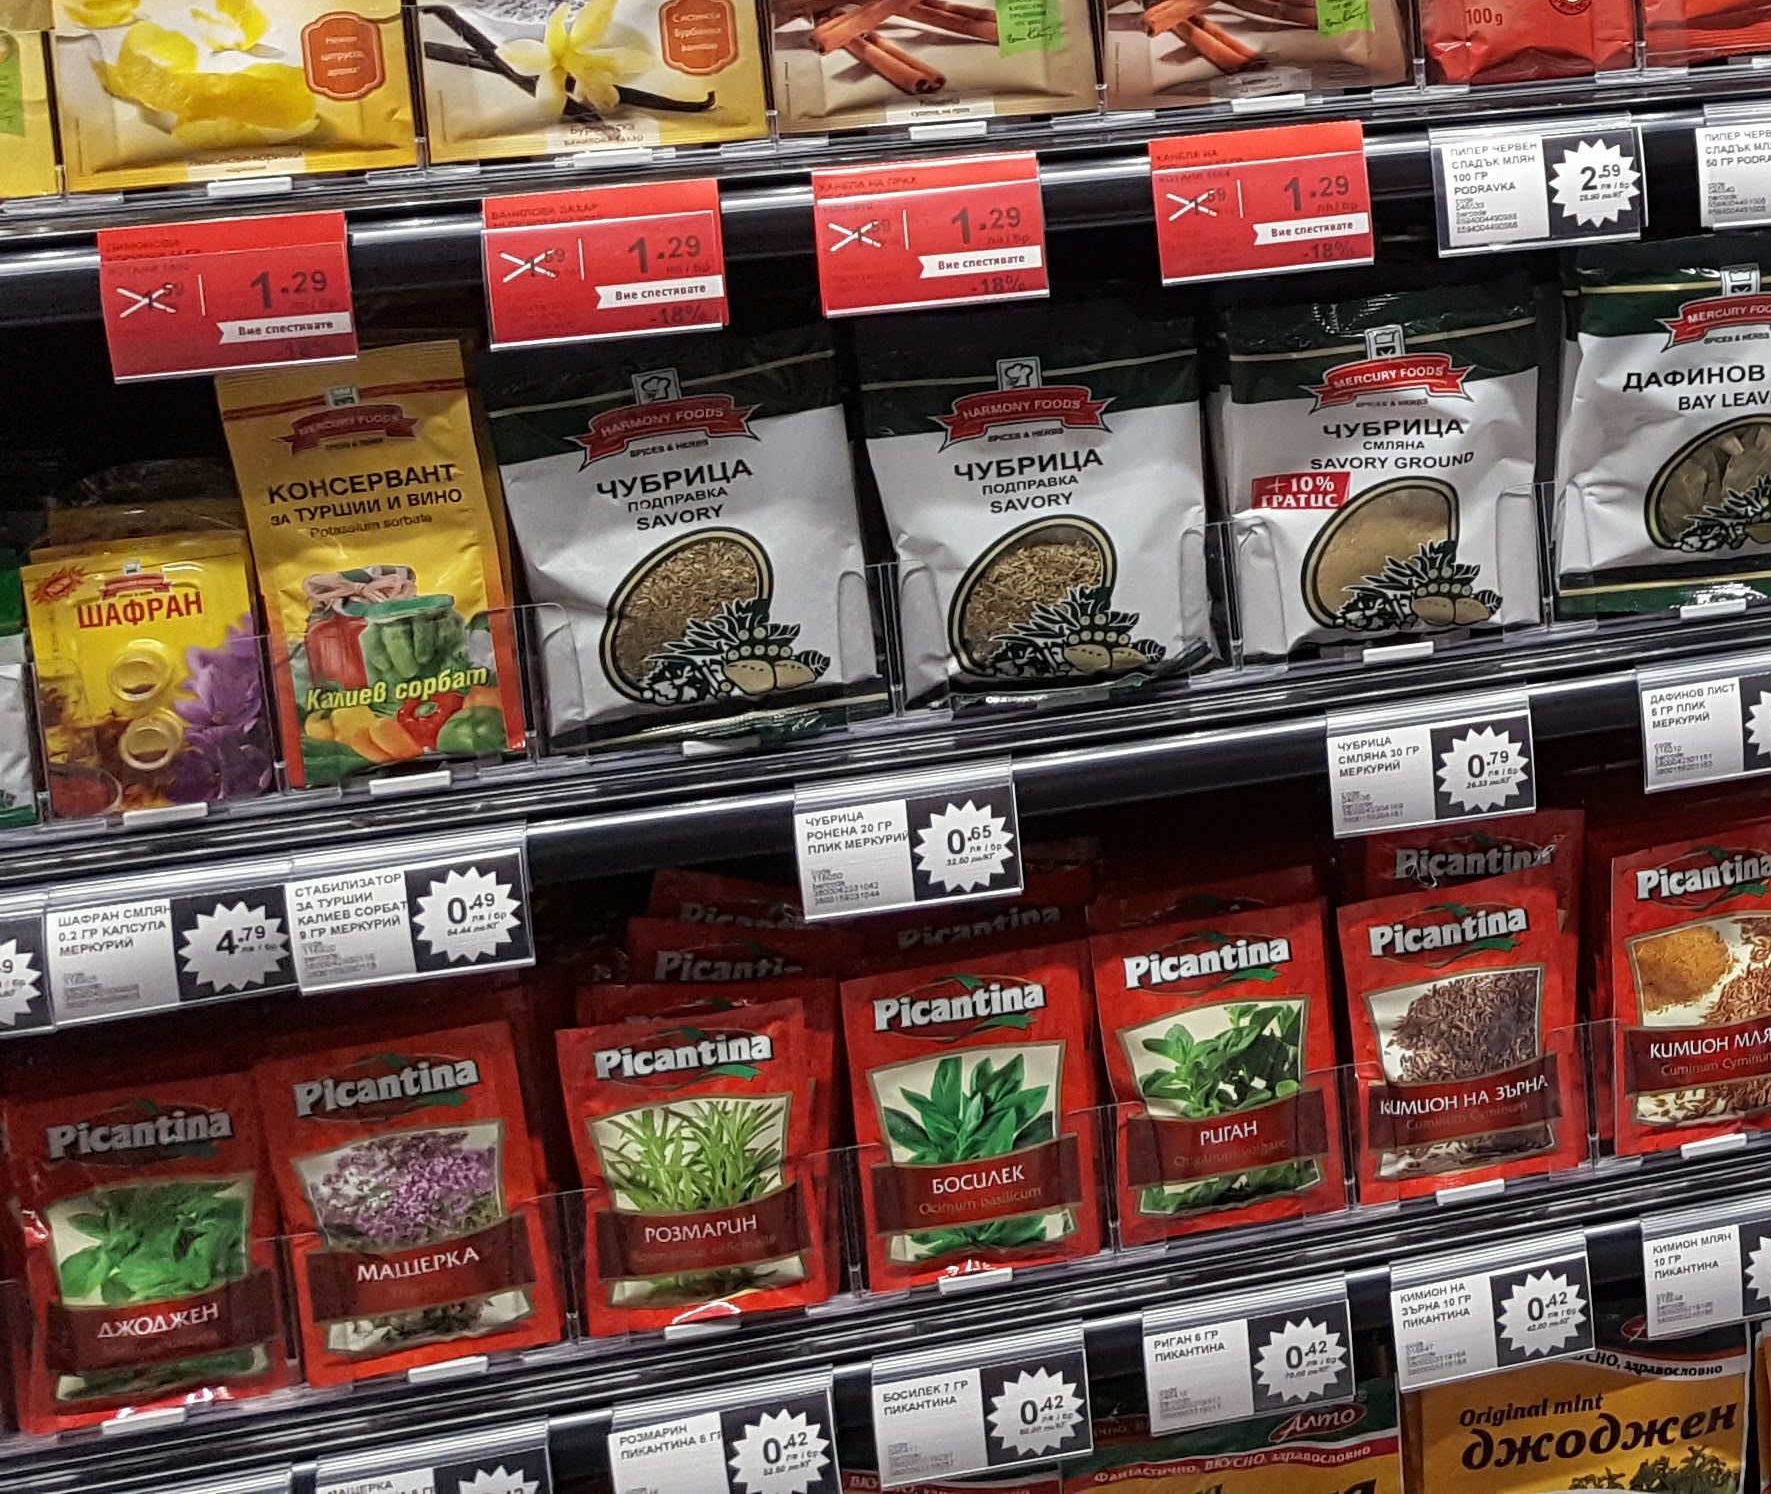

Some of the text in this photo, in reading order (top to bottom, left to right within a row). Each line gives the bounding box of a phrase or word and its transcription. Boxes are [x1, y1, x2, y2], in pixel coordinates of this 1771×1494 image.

[1450, 142, 1537, 157] ПИПЕР ЧЕРВЕН
[1452, 156, 1535, 169] СЛАДЪК МЛЯН
[1453, 171, 1488, 181] 100 ГР
[952, 207, 1022, 245] 1.29
[250, 271, 327, 309] 1.29
[1623, 364, 1764, 393] ДАФИНОВ
[1679, 392, 1715, 411] BAY
[954, 449, 1104, 482] ЧУБРИЦА
[1310, 452, 1473, 470] SAVORY GROUND
[268, 464, 455, 504] КОНСЕРВАНТ
[628, 486, 728, 512] ПОДПРАВКА
[990, 491, 1072, 514] SAVORY
[636, 505, 724, 530] SAVORY
[77, 592, 203, 629] ШАФРАН
[805, 811, 863, 828] ЧУБРИЦА
[295, 874, 402, 898] СТАБИЛИЗАТОР
[59, 912, 118, 927] ШАФРАН
[447, 893, 495, 924] 0.49
[60, 936, 133, 957] МЕРКУРИЙ
[217, 925, 266, 956] 4.79
[1123, 937, 1291, 987] Picantina
[45, 1109, 234, 1161] Picantina
[645, 1214, 757, 1243] РОЗМАРИН
[97, 1304, 219, 1338] ДЖОДЖЕН
[1528, 1292, 1569, 1322] 0.42
[883, 1385, 935, 1404] БОСИЛЕК
[1462, 1403, 1738, 1470] джоджен
